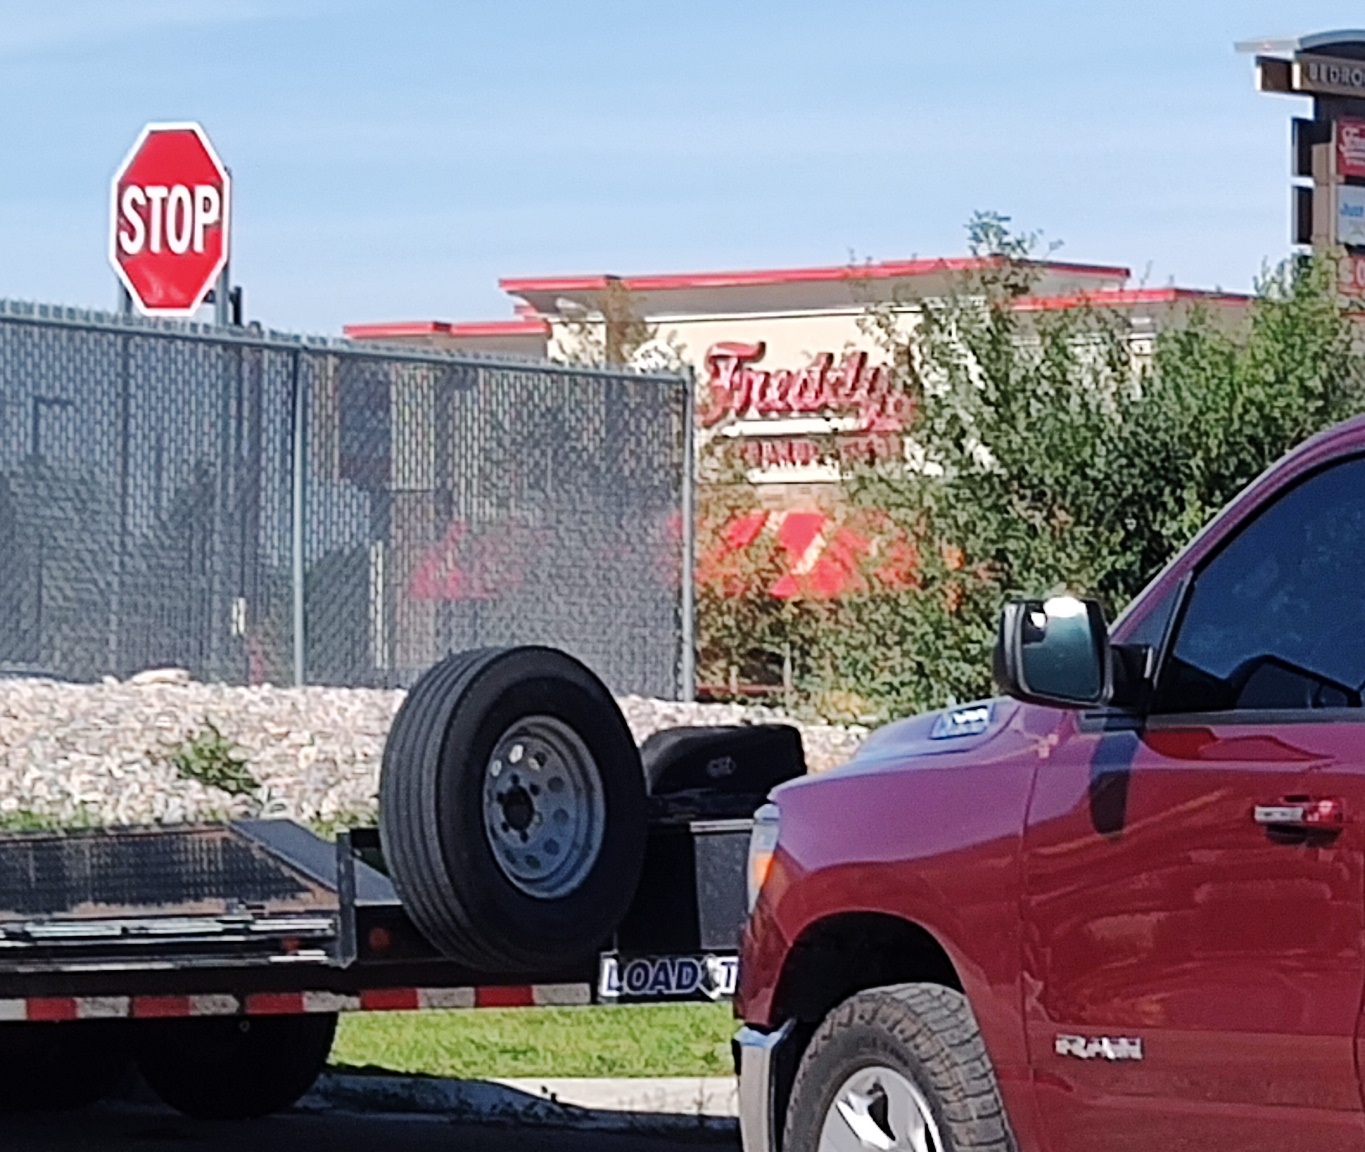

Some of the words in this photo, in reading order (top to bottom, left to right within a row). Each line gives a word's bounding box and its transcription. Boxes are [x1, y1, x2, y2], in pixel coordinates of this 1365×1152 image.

[119, 184, 220, 255] STOP
[602, 957, 700, 996] LOAD
[1055, 1034, 1144, 1060] RAM
